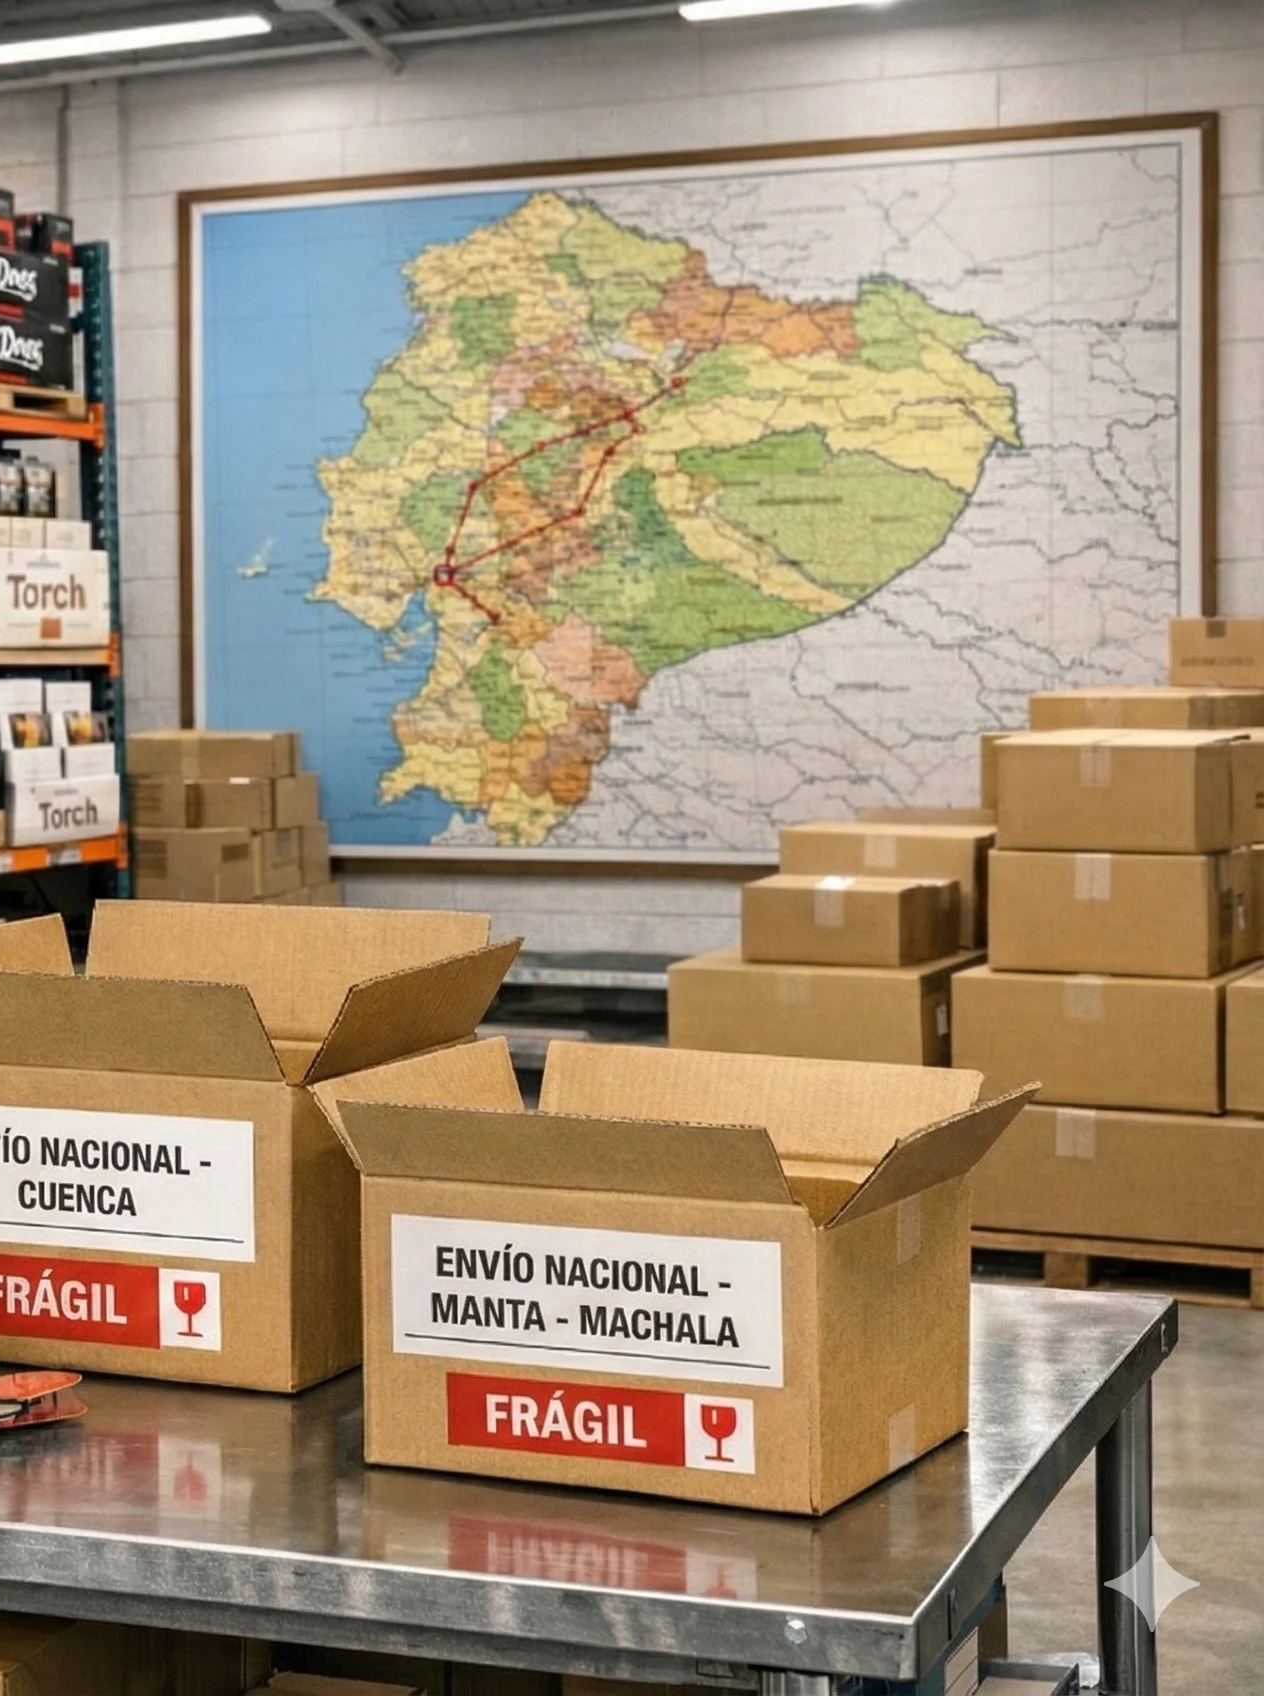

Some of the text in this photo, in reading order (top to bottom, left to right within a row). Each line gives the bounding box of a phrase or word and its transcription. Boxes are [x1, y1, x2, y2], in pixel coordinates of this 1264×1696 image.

[6, 573, 87, 610] Torch
[39, 798, 98, 831] Torch
[40, 1136, 190, 1176] NACIONAL
[18, 1180, 137, 1217] CUENCA
[436, 1243, 534, 1284] ENVÍO
[545, 1255, 709, 1298] NACIONAL
[431, 1292, 546, 1332] MANTA
[579, 1305, 739, 1349] MACHALA
[486, 1390, 648, 1449] FRÁGIL
